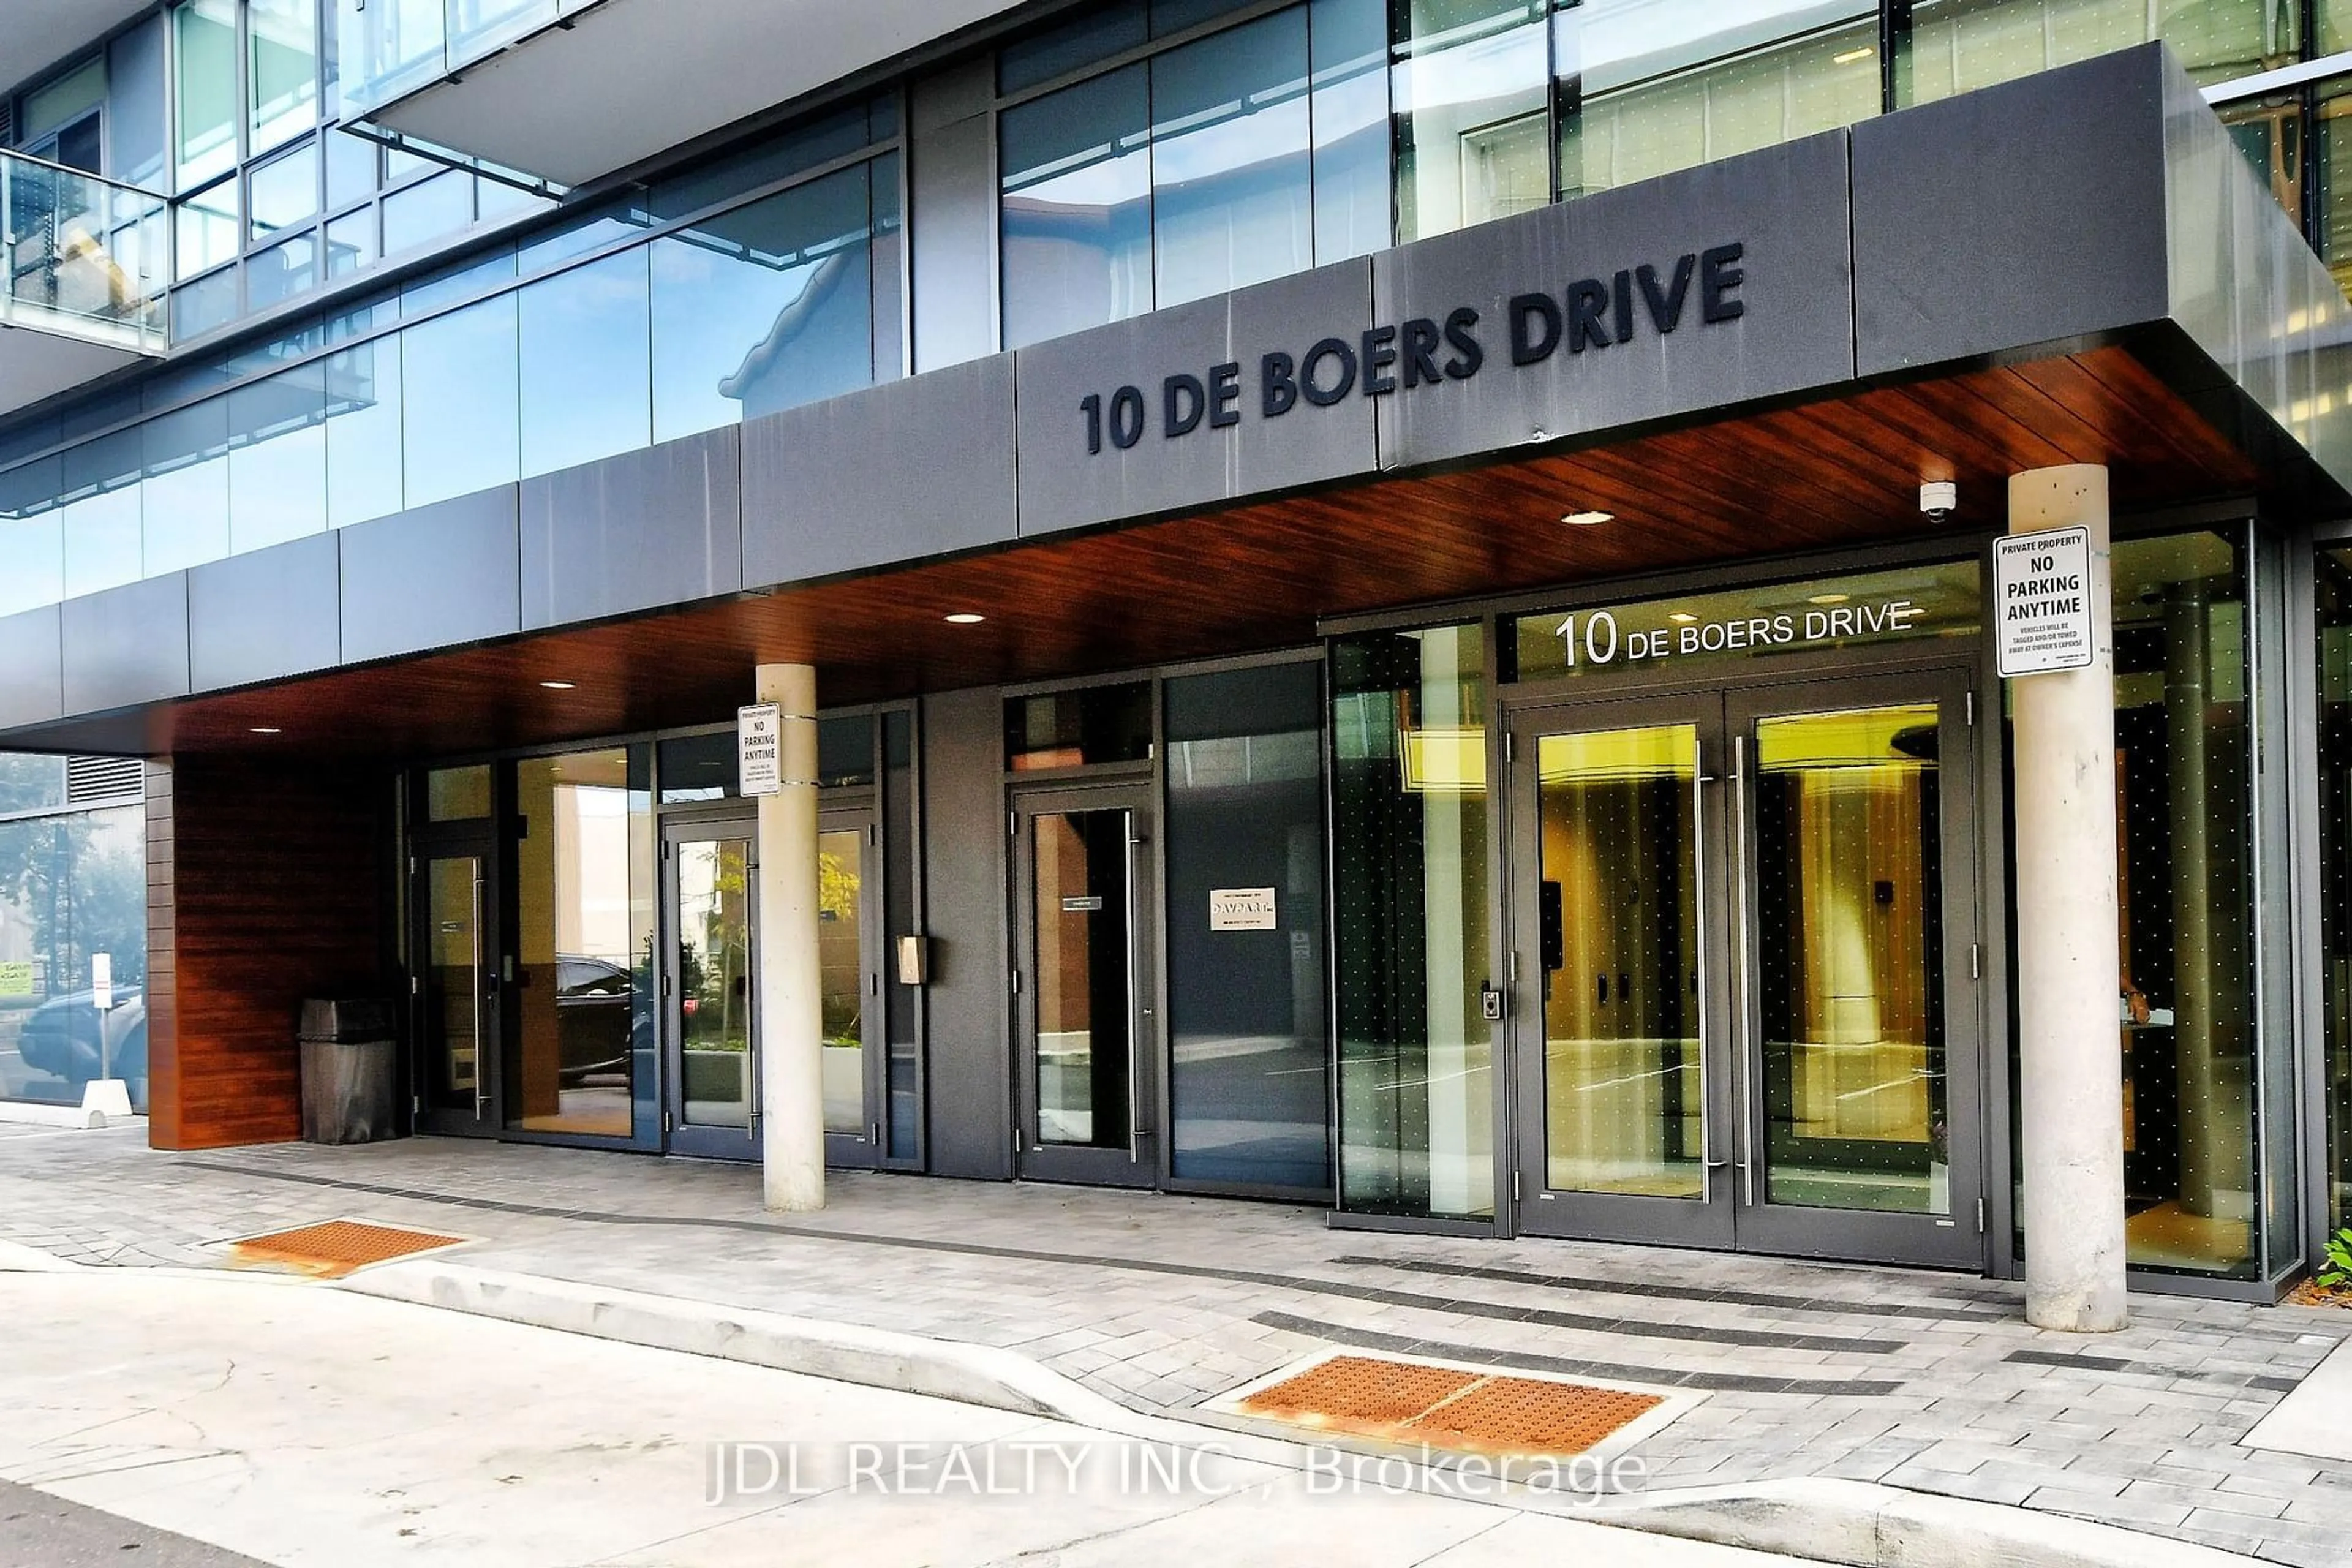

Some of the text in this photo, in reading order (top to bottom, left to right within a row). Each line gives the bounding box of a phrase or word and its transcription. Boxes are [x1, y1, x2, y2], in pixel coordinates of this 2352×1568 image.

[1080, 242, 1744, 454] 10 DE BOERS DRIVE
[2002, 535, 2082, 555] PRIVATE PROPERTY
[2030, 556, 2054, 573] NO
[2008, 575, 2079, 598] PARKING
[2007, 597, 2081, 620] ANYTIME
[1555, 600, 1912, 666] 10 DE BOERS DRIVE
[754, 721, 764, 731] NO
[744, 734, 775, 747] PARKING
[744, 748, 775, 761] ANYTIME
